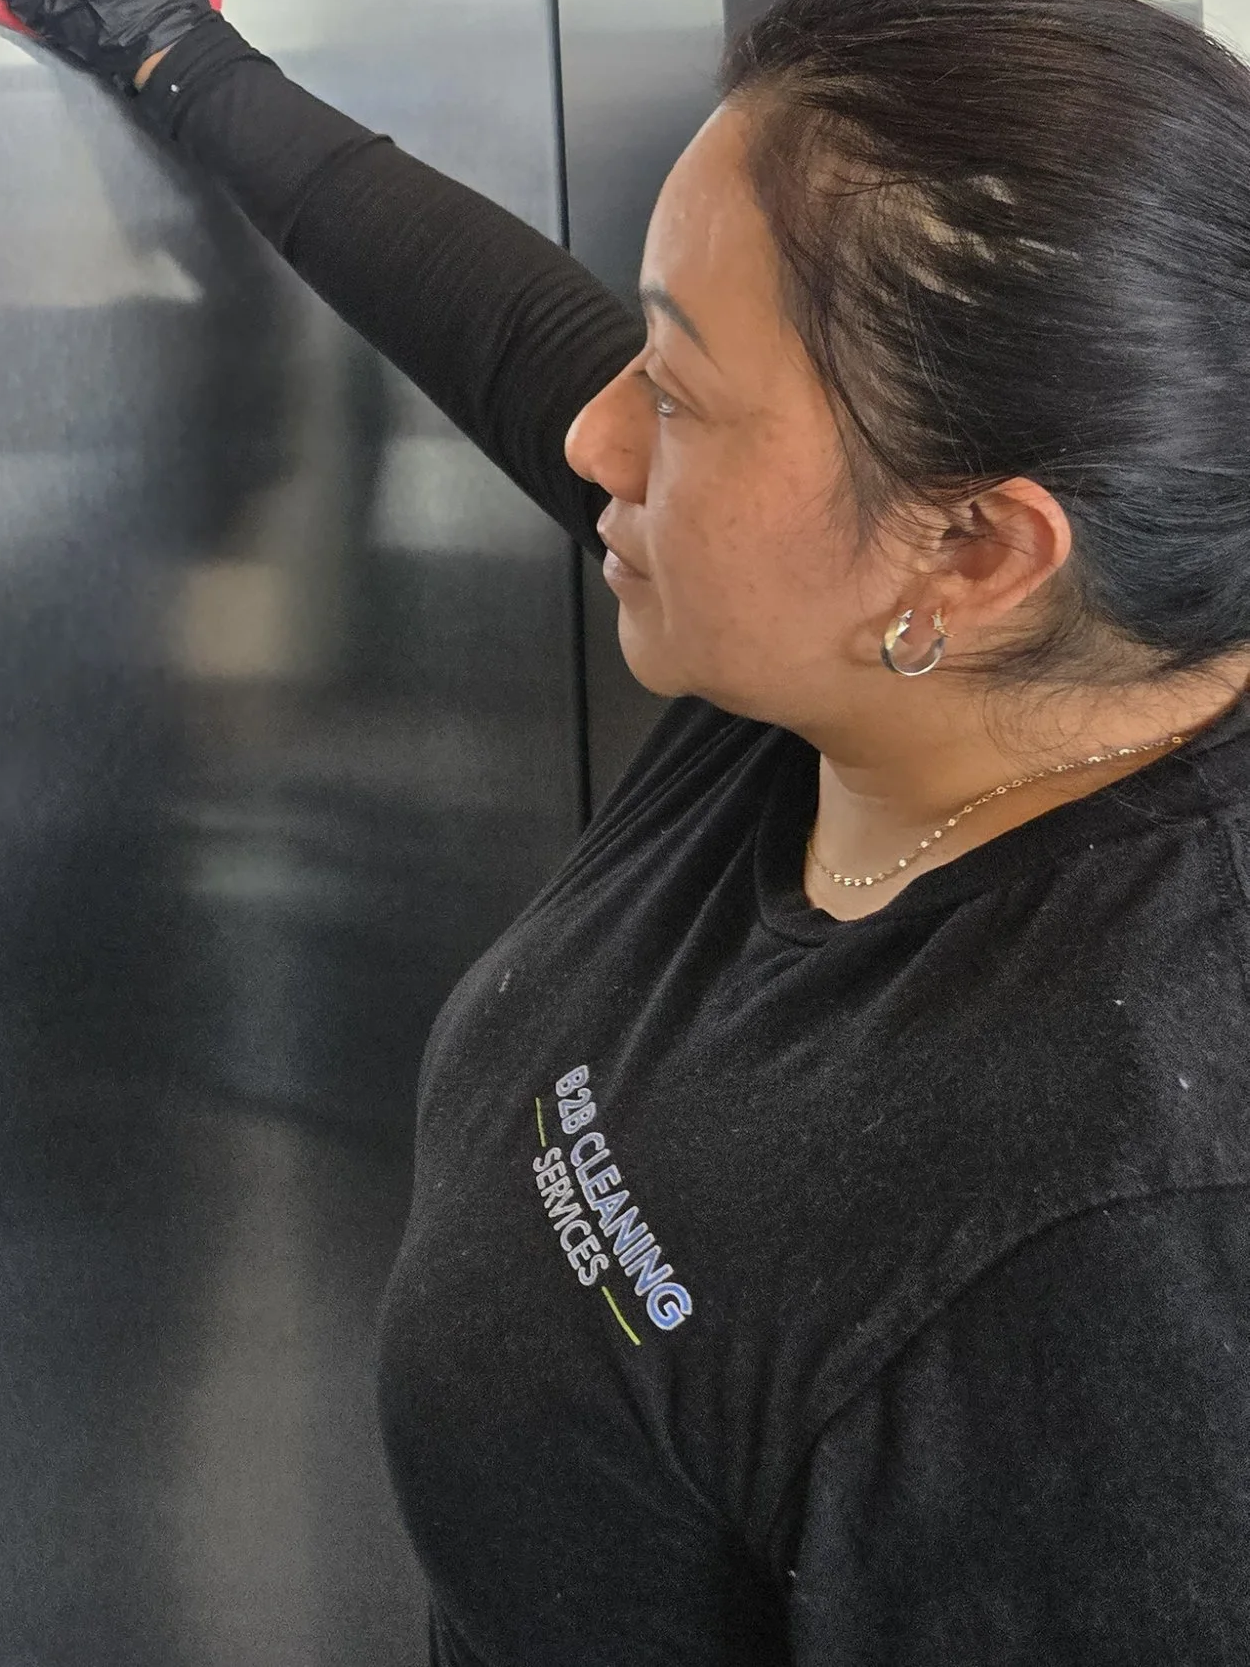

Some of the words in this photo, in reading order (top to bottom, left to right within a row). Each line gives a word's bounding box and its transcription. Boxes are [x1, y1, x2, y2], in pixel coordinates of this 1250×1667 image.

[556, 1065, 596, 1134] B2B
[533, 1147, 609, 1285] SERVICES
[570, 1132, 692, 1330] CLEANING
